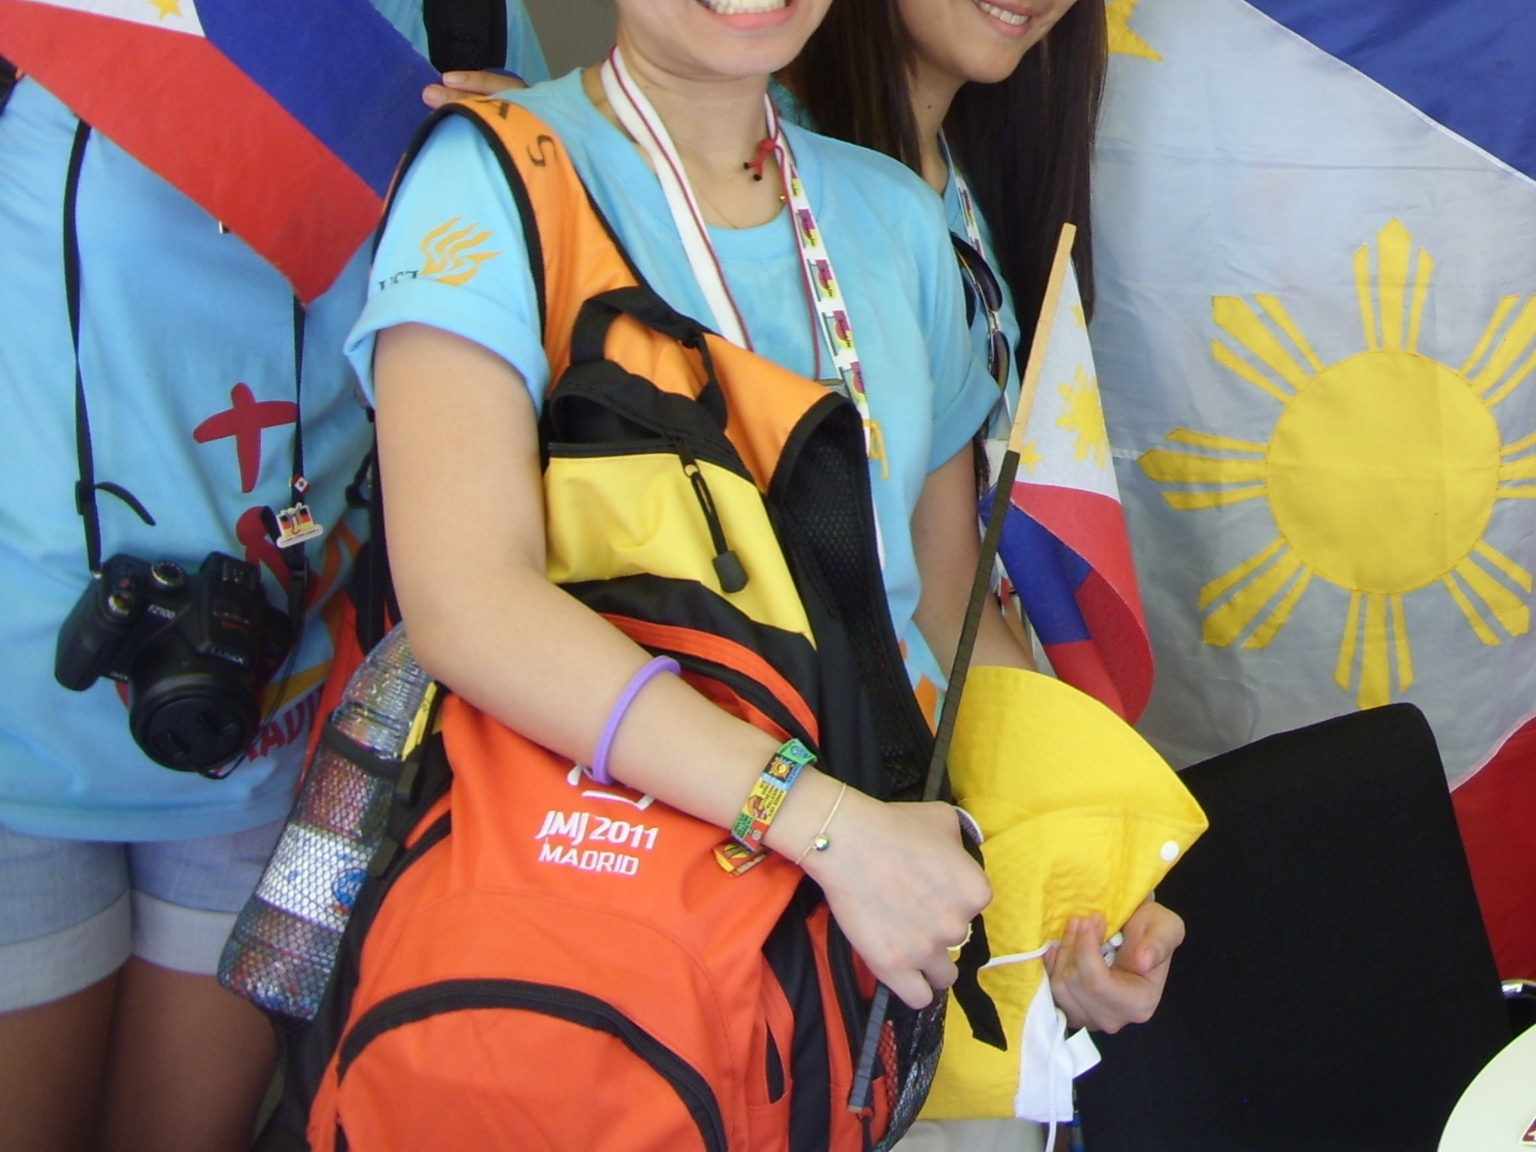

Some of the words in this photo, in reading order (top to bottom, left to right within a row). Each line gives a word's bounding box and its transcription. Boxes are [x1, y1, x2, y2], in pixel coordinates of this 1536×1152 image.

[534, 809, 591, 846] JMJ
[588, 815, 659, 850] 2011
[538, 841, 640, 876] MADRID
